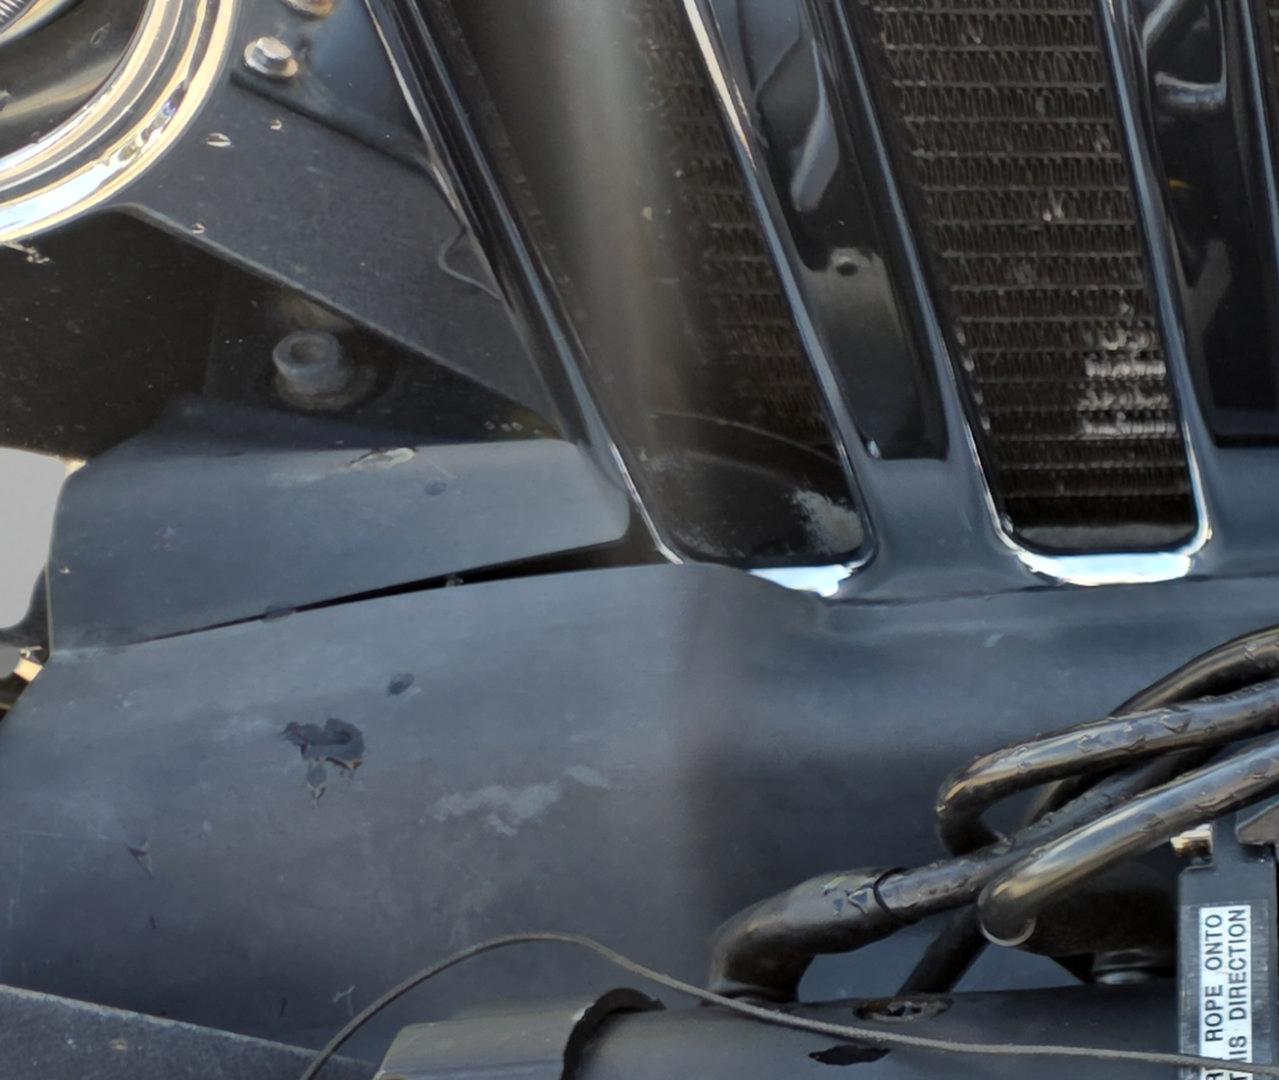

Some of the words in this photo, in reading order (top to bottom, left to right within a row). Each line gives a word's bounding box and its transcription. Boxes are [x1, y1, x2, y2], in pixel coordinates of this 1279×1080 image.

[1204, 914, 1224, 970] ONTO
[1228, 909, 1248, 1020] DIRECTION
[1204, 984, 1224, 1042] ROPE
